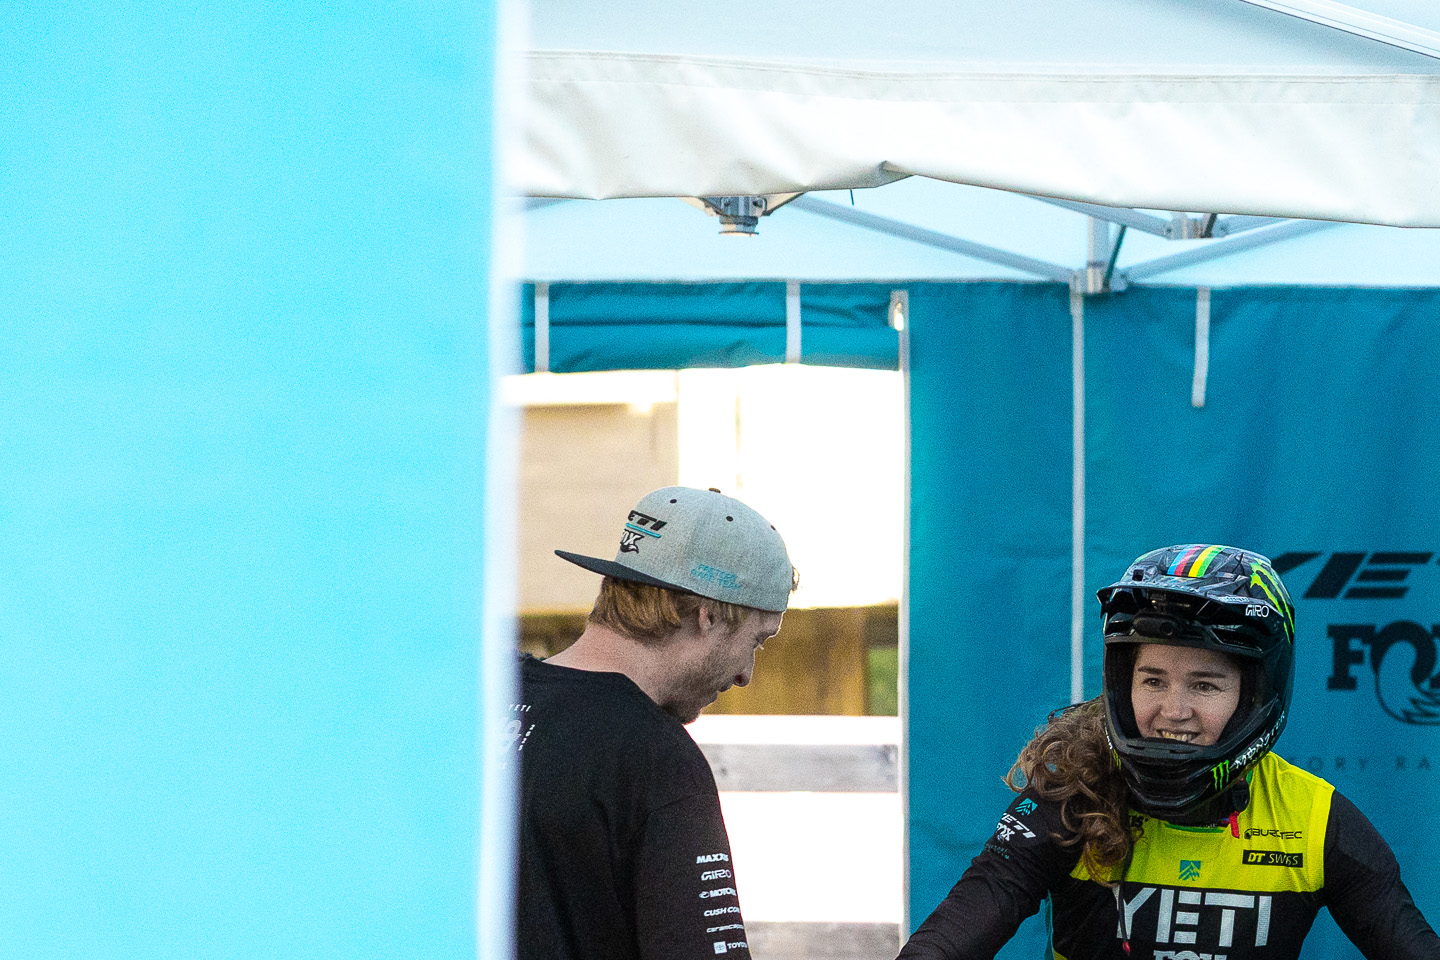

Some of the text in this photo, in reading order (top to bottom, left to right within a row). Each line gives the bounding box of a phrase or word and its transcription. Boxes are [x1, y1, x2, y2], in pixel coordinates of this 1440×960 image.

[628, 510, 667, 531] ETI
[1245, 604, 1269, 618] GIRO
[1001, 812, 1036, 838] ETI
[1247, 852, 1266, 863] DT
[1112, 886, 1273, 948] YETI
